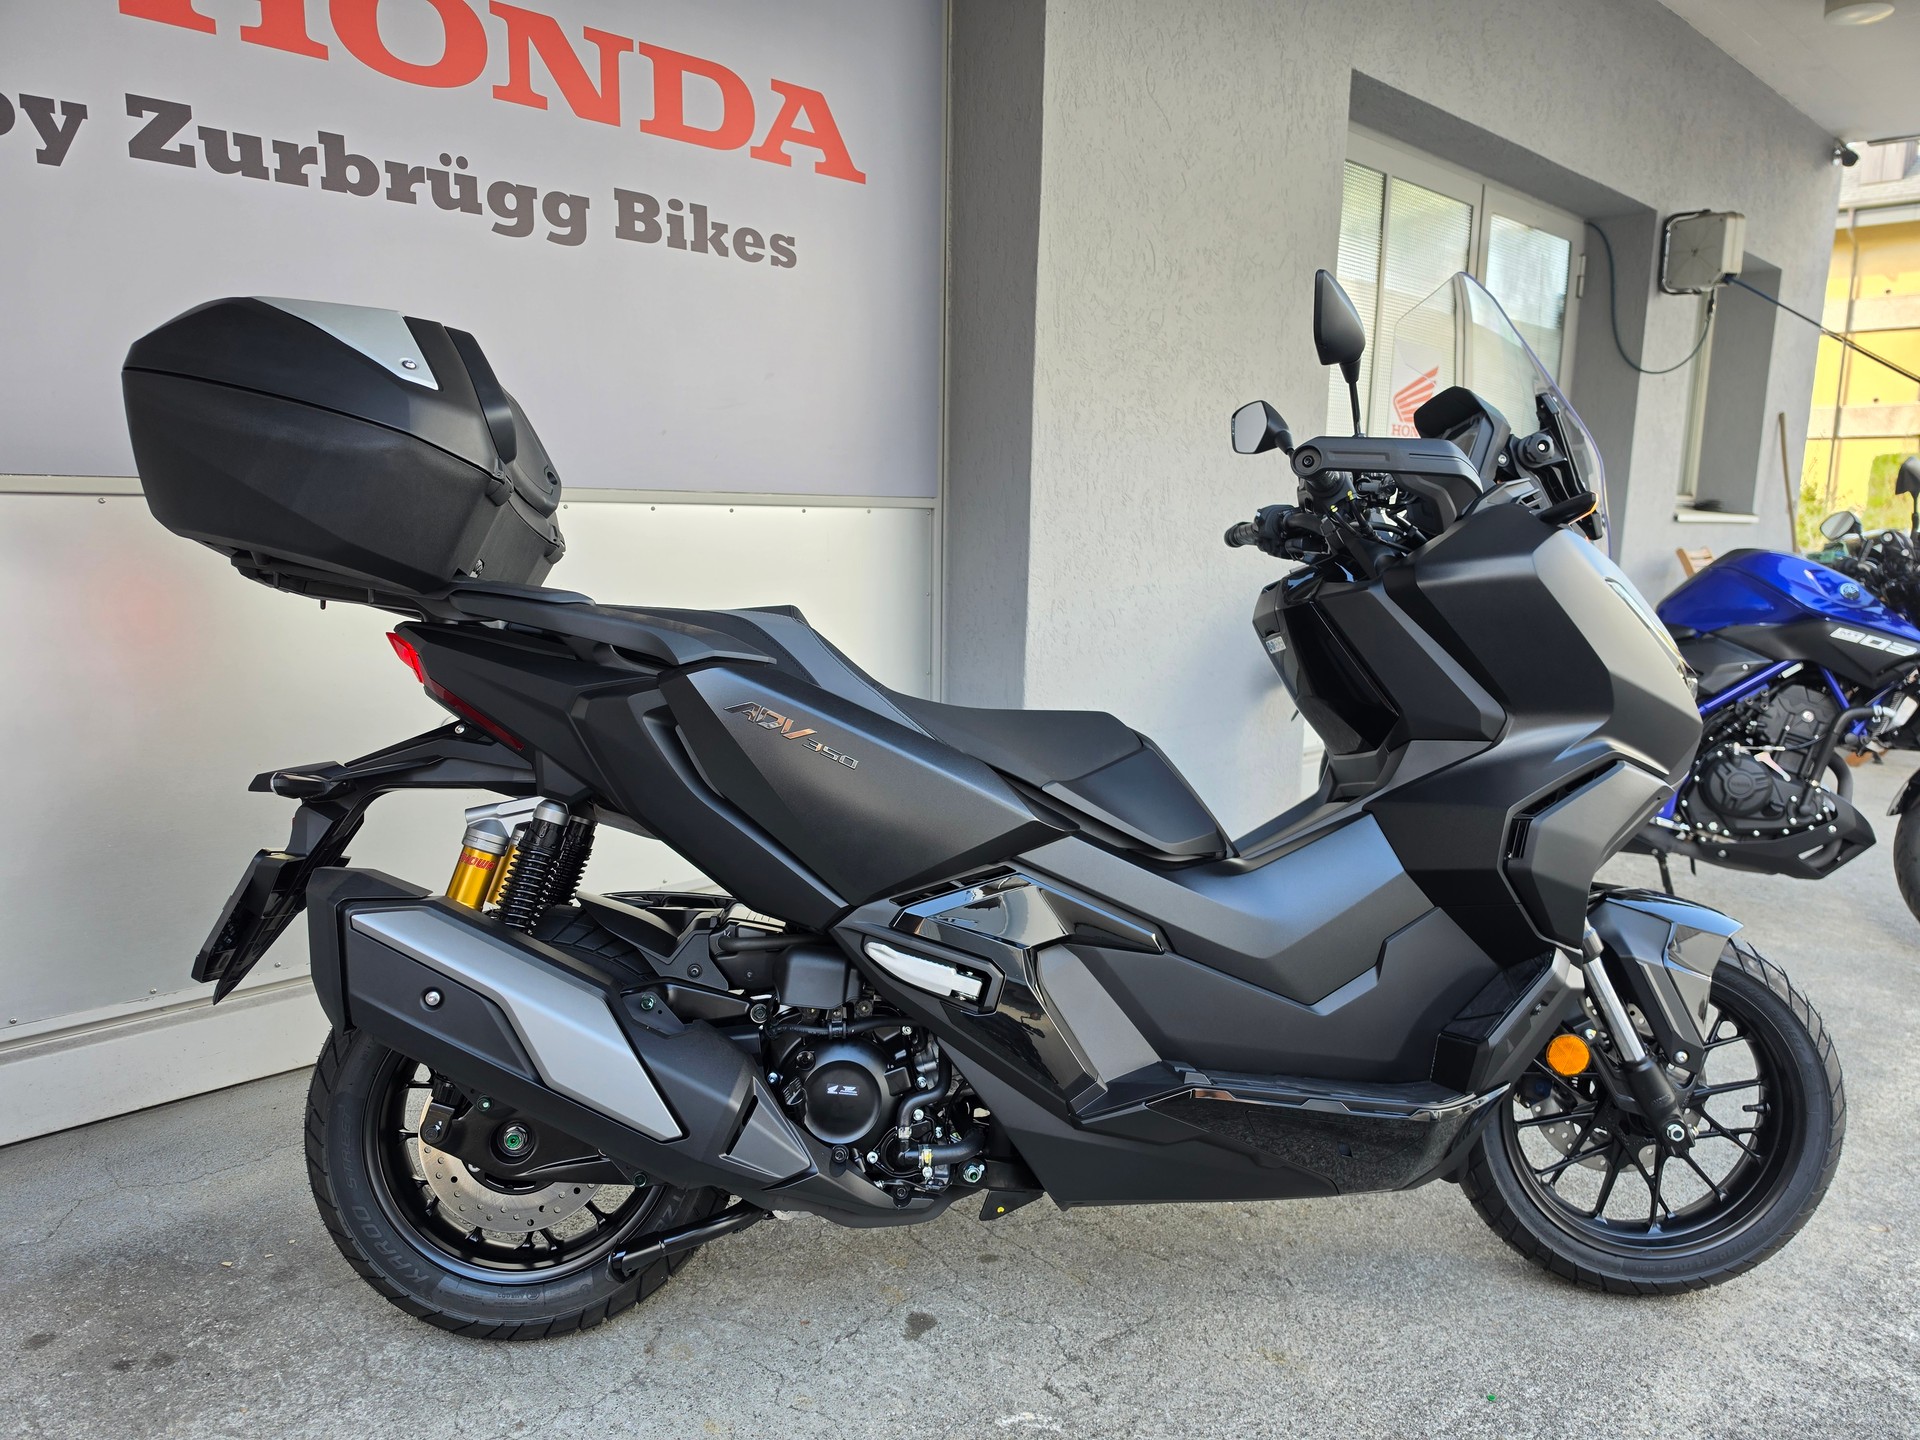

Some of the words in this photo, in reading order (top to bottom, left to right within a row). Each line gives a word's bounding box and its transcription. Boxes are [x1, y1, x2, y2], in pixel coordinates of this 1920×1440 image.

[125, 92, 590, 247] Zurbrügg
[613, 187, 797, 269] Bikes
[1392, 424, 1418, 437] HON
[351, 1205, 431, 1285] KAROO
